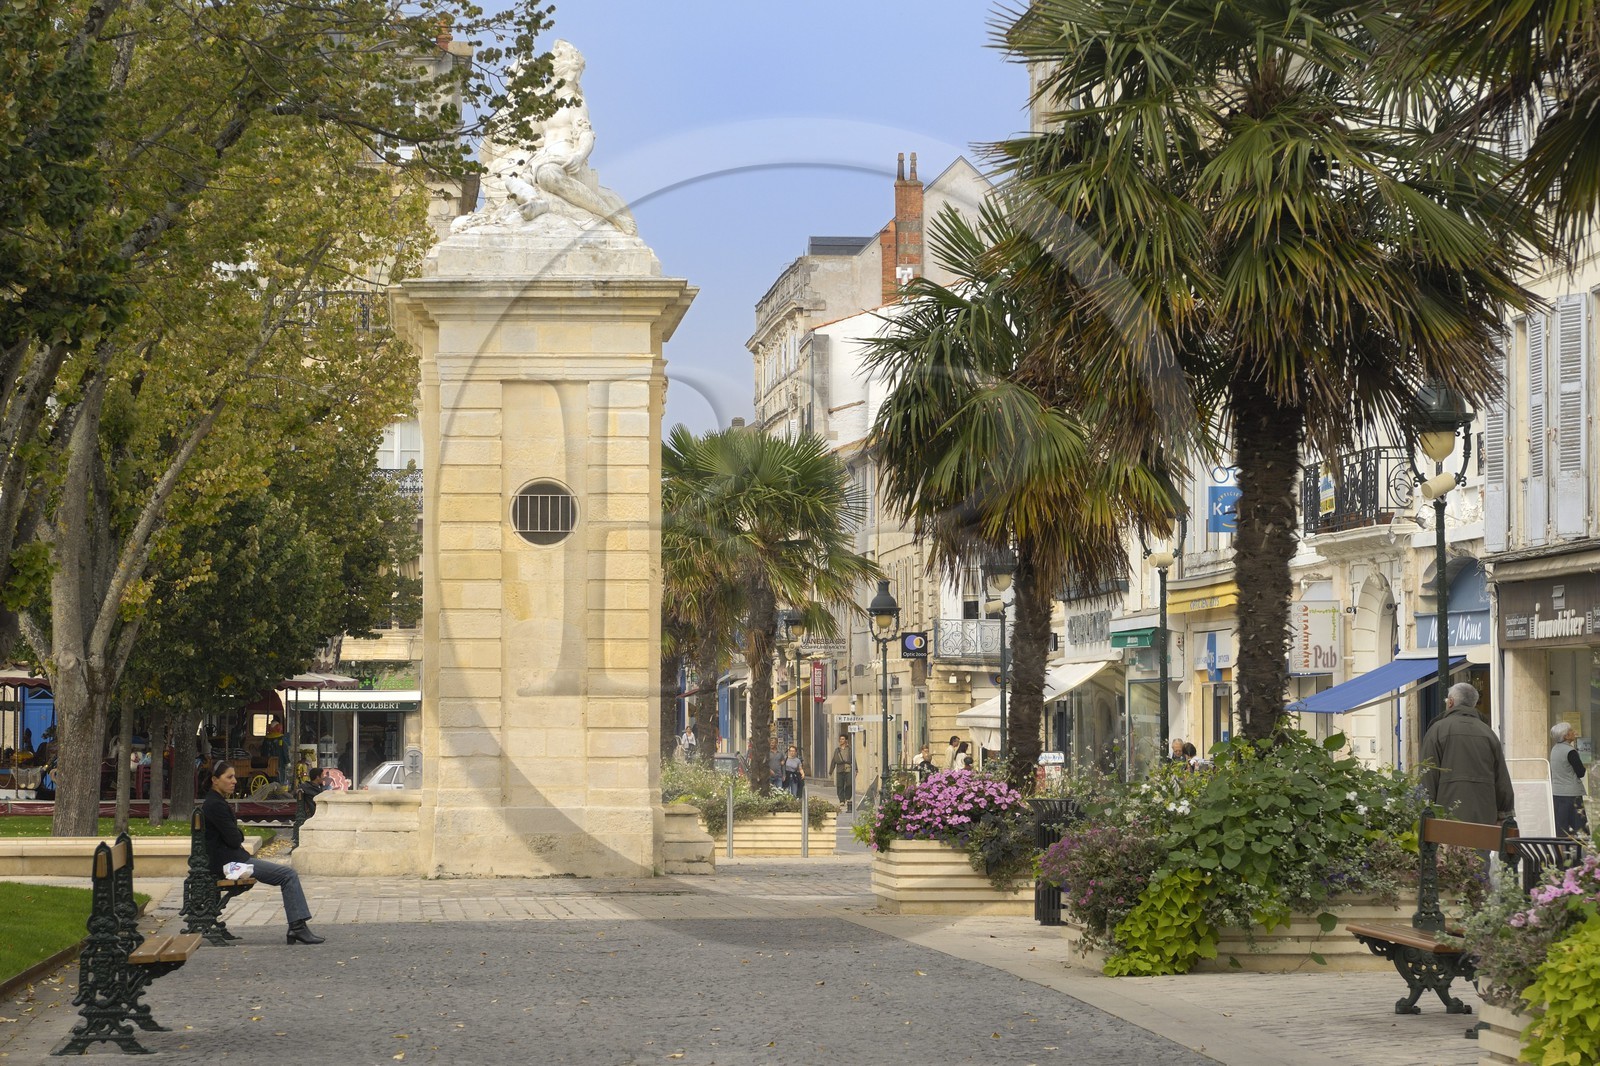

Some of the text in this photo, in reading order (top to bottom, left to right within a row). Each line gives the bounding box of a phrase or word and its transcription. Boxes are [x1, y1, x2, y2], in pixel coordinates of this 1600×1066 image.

[1313, 644, 1337, 668] Pub
[814, 667, 822, 698] SUD OUEST
